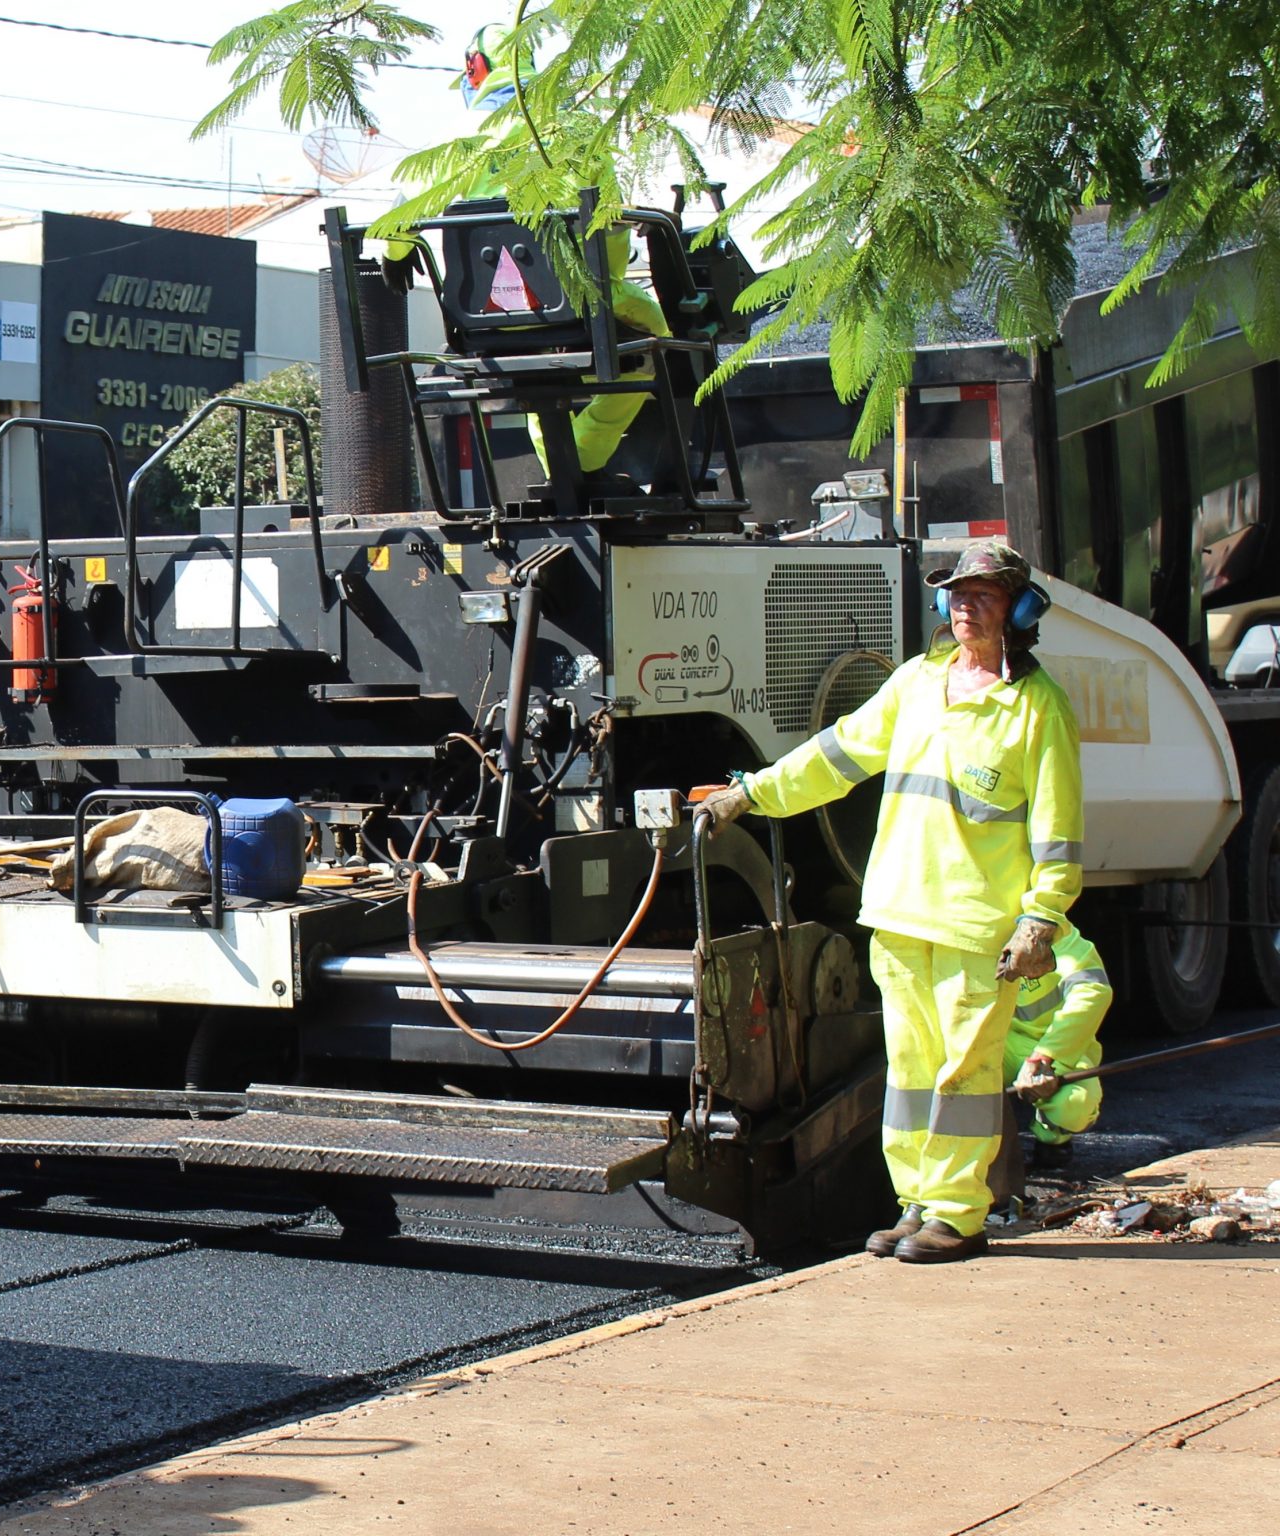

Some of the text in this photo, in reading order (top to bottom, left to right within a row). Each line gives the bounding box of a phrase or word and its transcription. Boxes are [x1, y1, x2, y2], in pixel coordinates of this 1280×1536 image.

[97, 274, 211, 314] AUTO ESCOLA
[65, 311, 241, 359] GUAIRENSE
[653, 591, 718, 619] VDA 700
[654, 668, 676, 681] DUAL
[731, 687, 765, 714] VA-03
